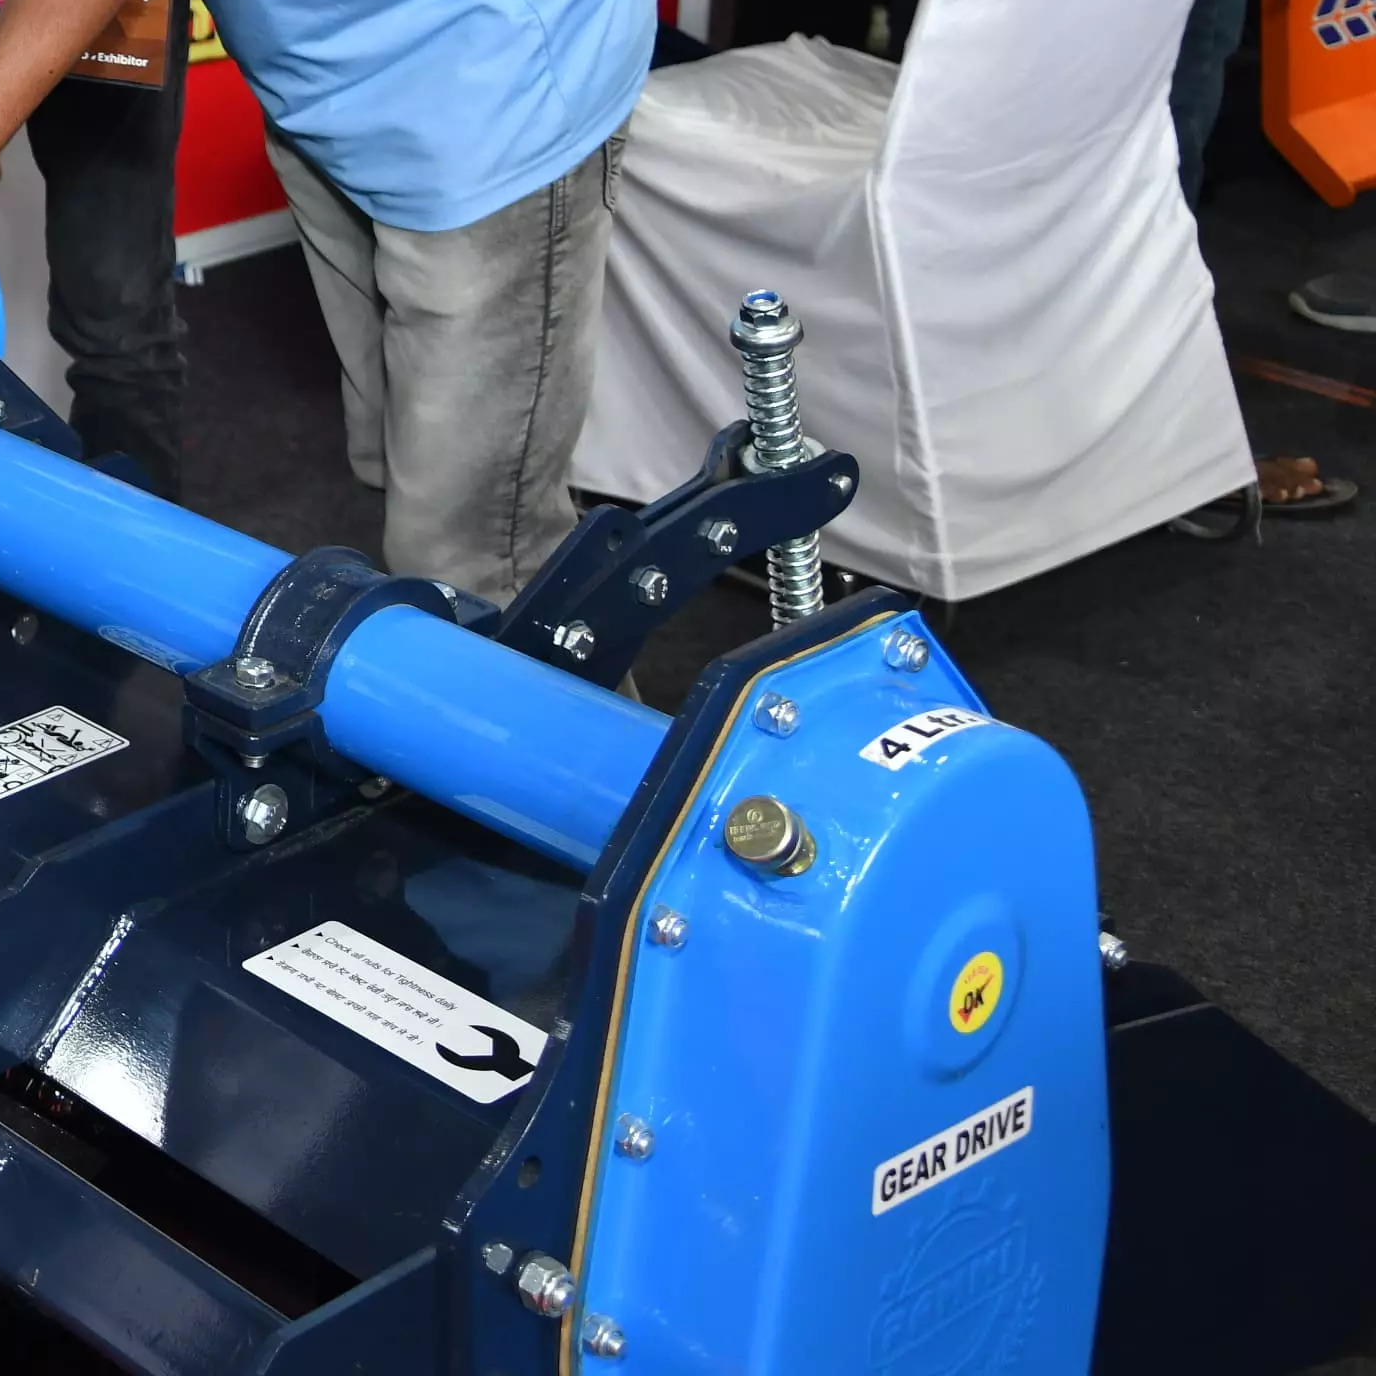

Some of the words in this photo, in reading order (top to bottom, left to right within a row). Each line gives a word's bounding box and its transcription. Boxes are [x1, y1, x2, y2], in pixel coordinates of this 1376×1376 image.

[97, 51, 149, 67] Exhibitor
[880, 737, 912, 760] 4
[902, 713, 978, 739] Ltr.
[325, 936, 352, 955] Check
[351, 949, 365, 960] all
[362, 957, 382, 971] nuts
[382, 966, 397, 978] for
[397, 974, 436, 1000] Tightness
[435, 995, 458, 1012] daily
[963, 986, 986, 1015] OK
[880, 1140, 946, 1203] GEAR
[955, 1097, 1027, 1165] DRIVE
